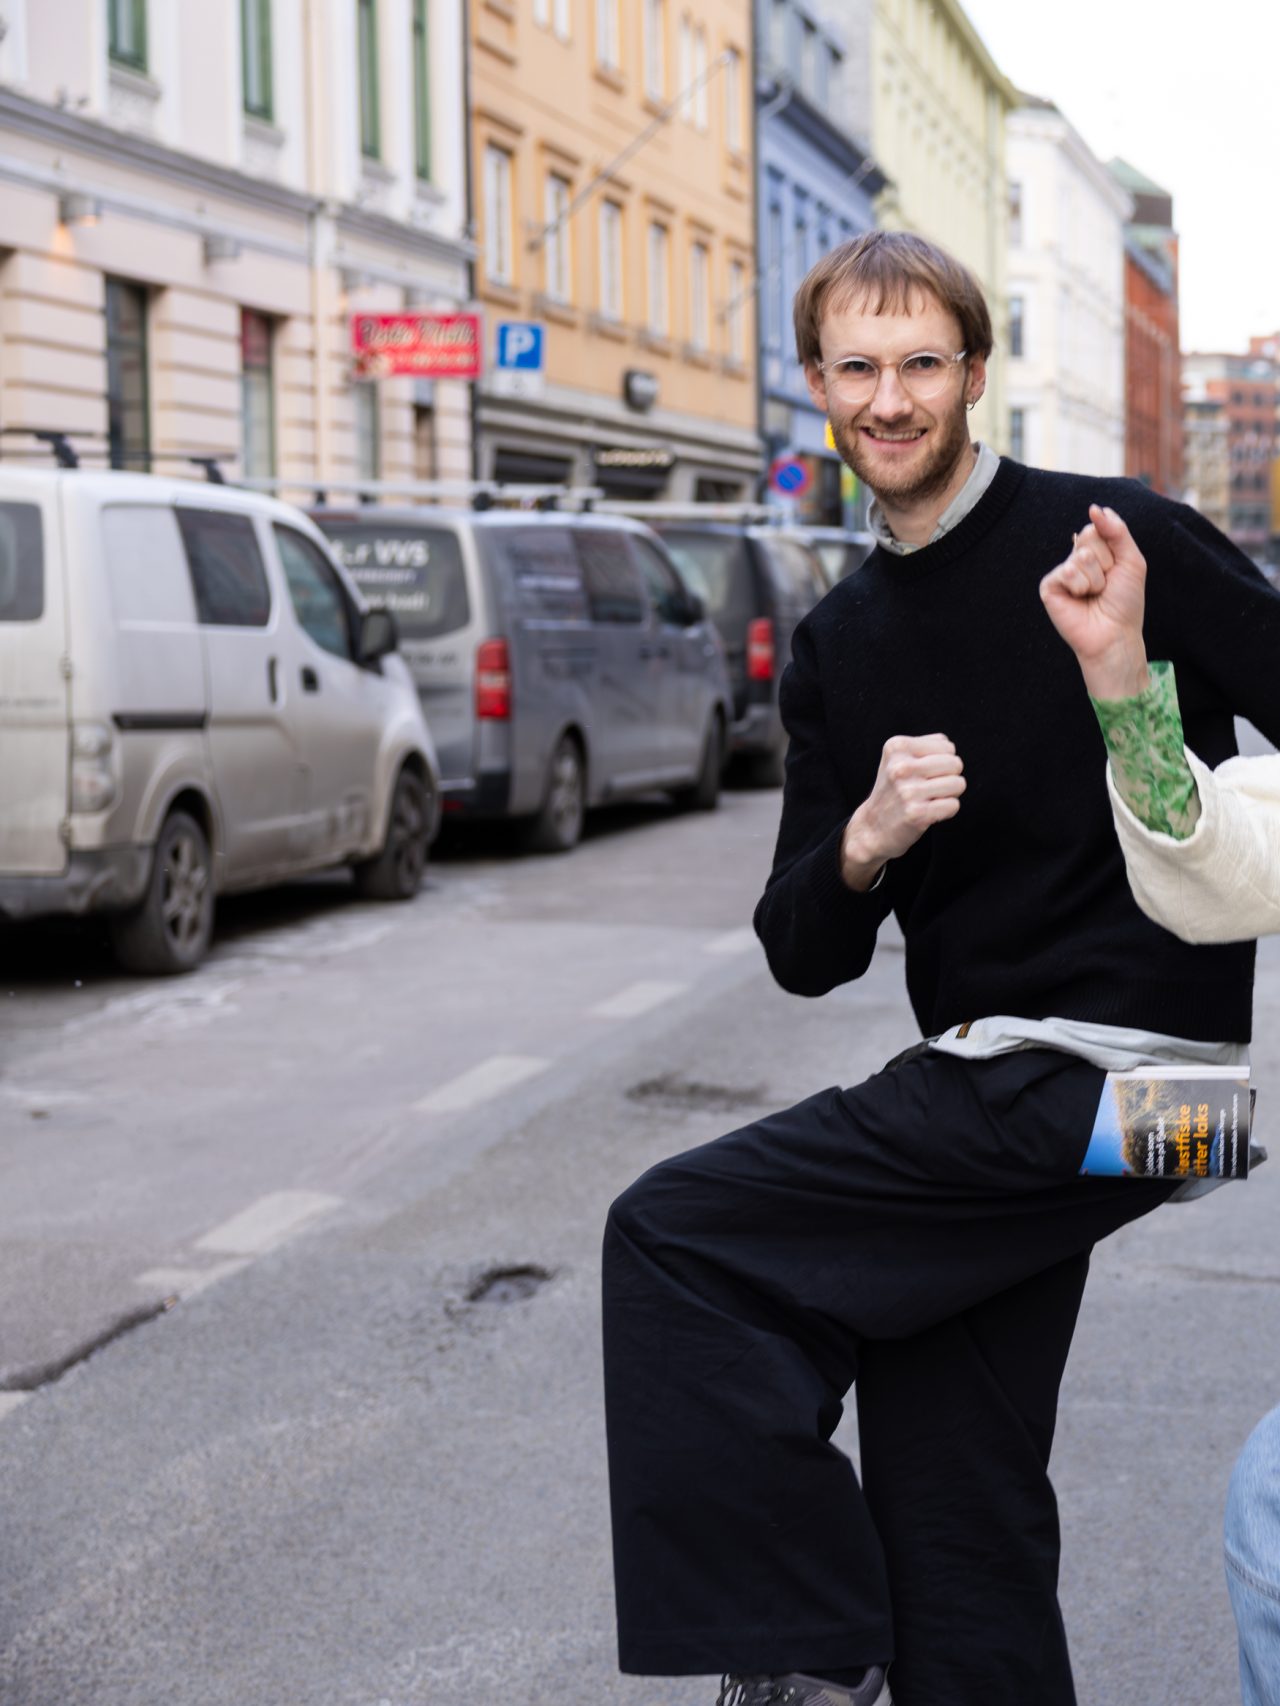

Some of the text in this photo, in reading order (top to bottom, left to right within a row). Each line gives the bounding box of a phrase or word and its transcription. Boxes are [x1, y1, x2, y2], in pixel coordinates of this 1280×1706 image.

[505, 327, 535, 366] P
[374, 539, 430, 567] VVS
[1193, 1104, 1208, 1138] laks
